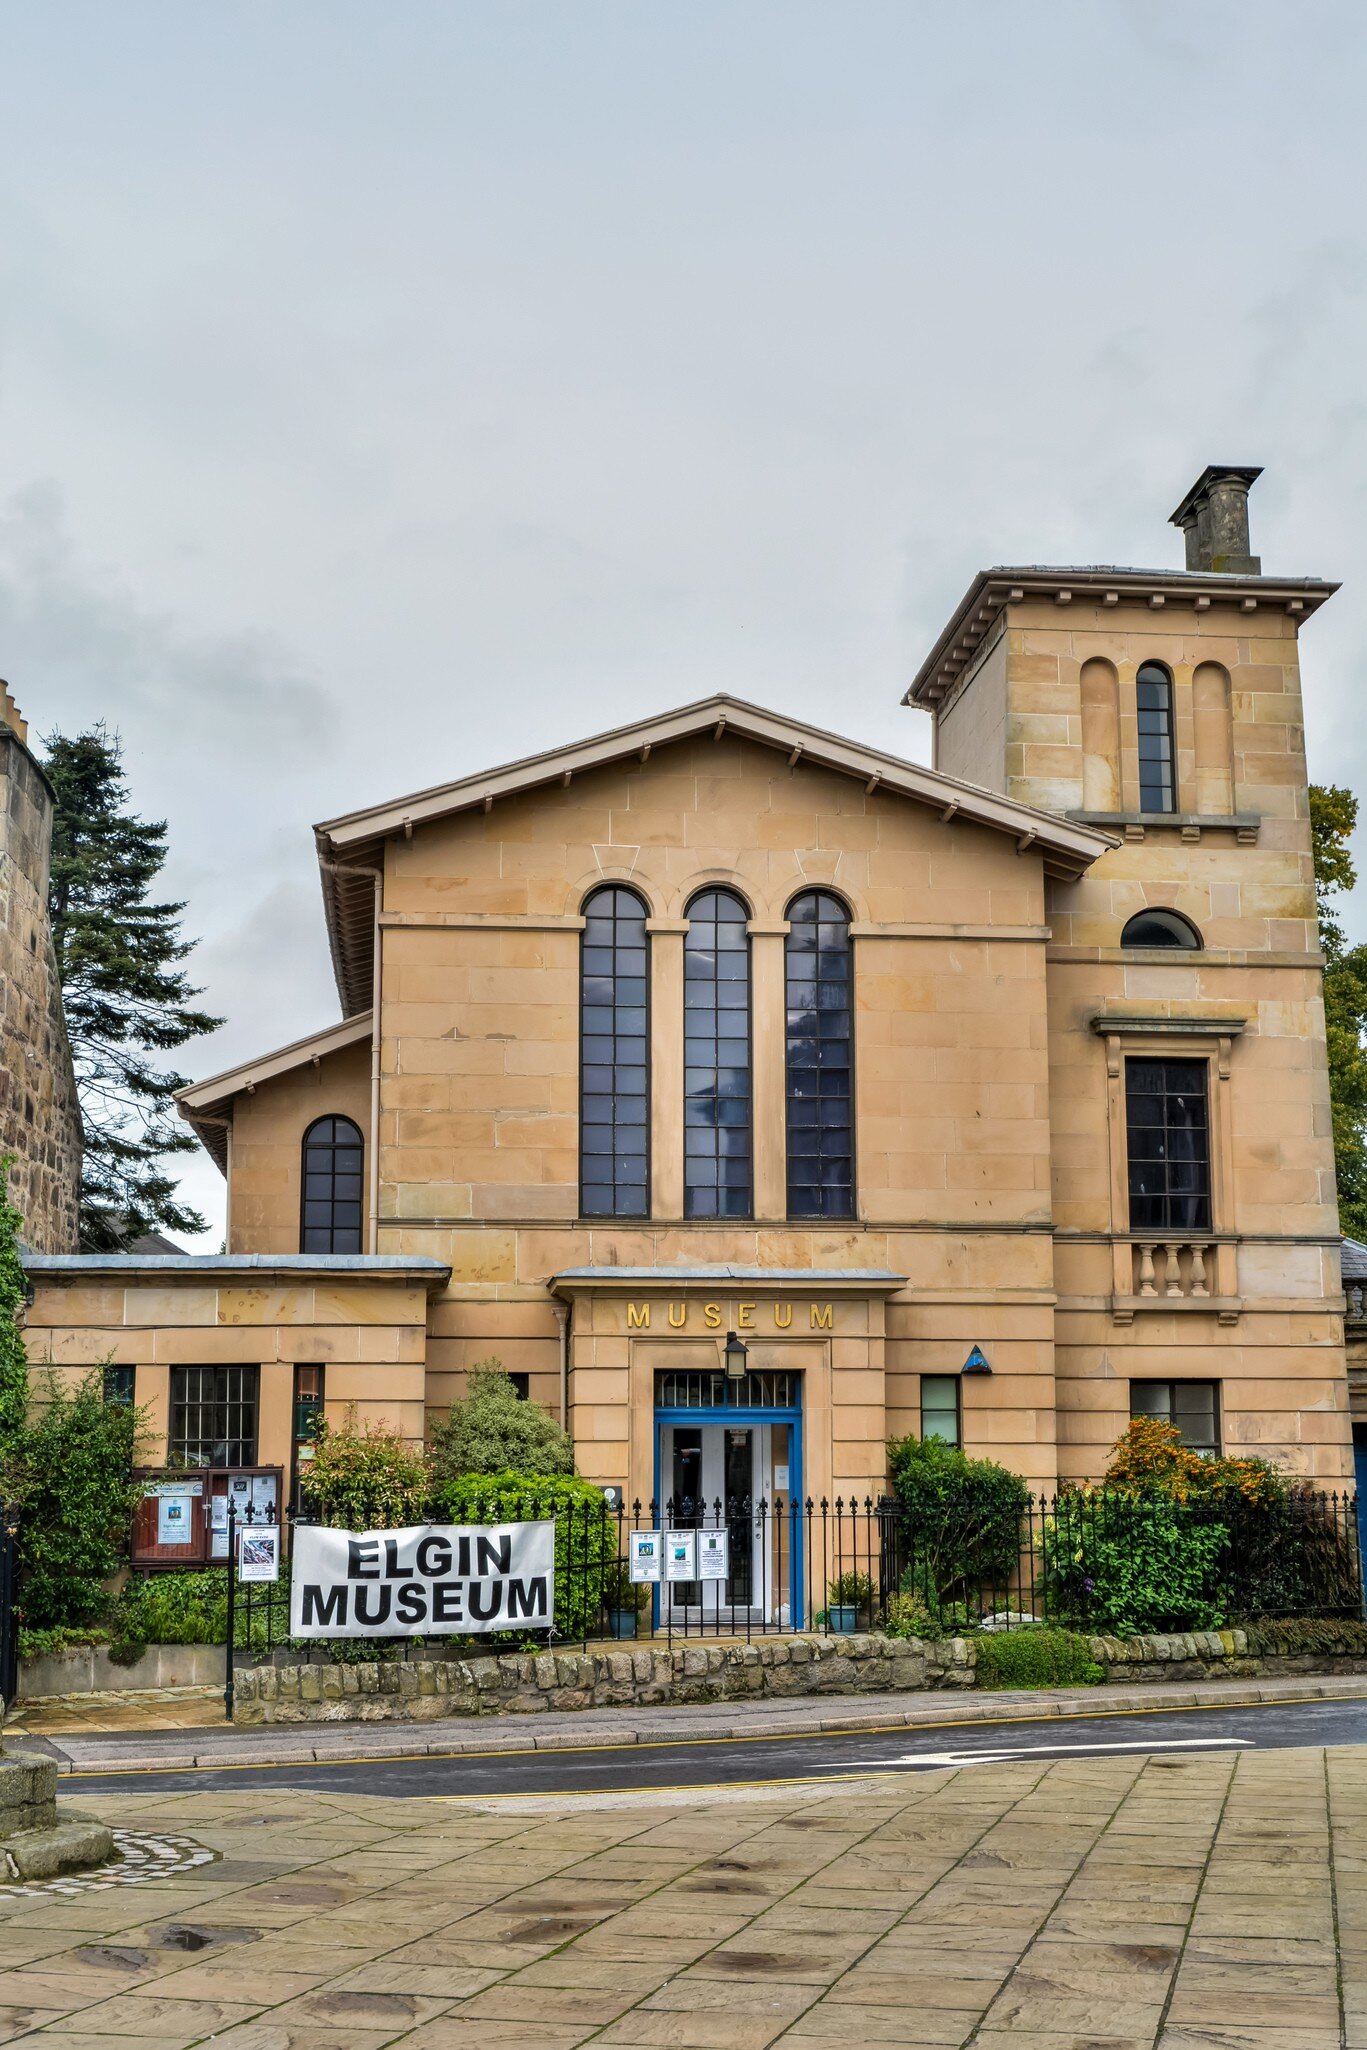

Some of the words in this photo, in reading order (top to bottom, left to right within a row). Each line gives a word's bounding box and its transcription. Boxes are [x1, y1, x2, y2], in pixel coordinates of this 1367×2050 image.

[627, 1303, 833, 1328] MUSEUM
[347, 1535, 511, 1580] ELGIN
[301, 1576, 548, 1626] MUSEUM
